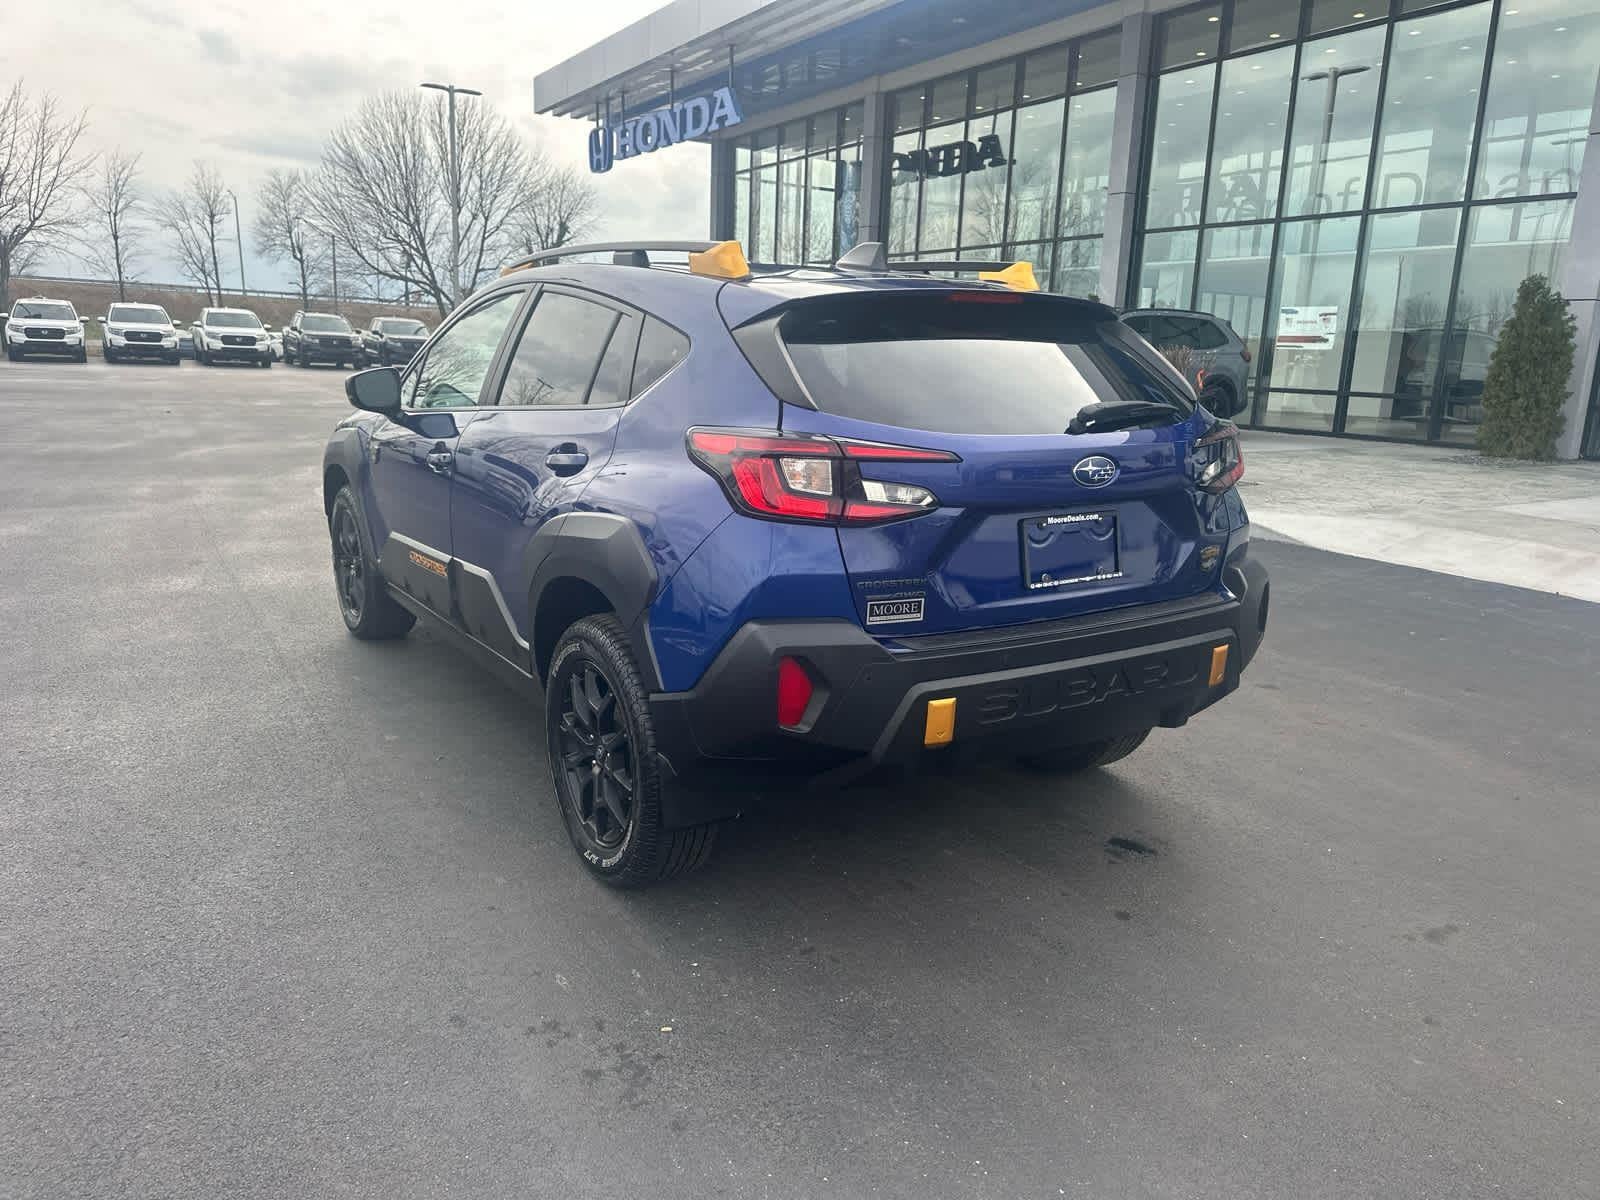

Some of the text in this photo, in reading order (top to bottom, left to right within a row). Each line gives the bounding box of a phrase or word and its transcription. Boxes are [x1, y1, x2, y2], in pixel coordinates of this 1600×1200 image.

[613, 86, 743, 161] HONDA
[1047, 513, 1100, 525] MooreDeals.com
[873, 603, 919, 615] MOORE
